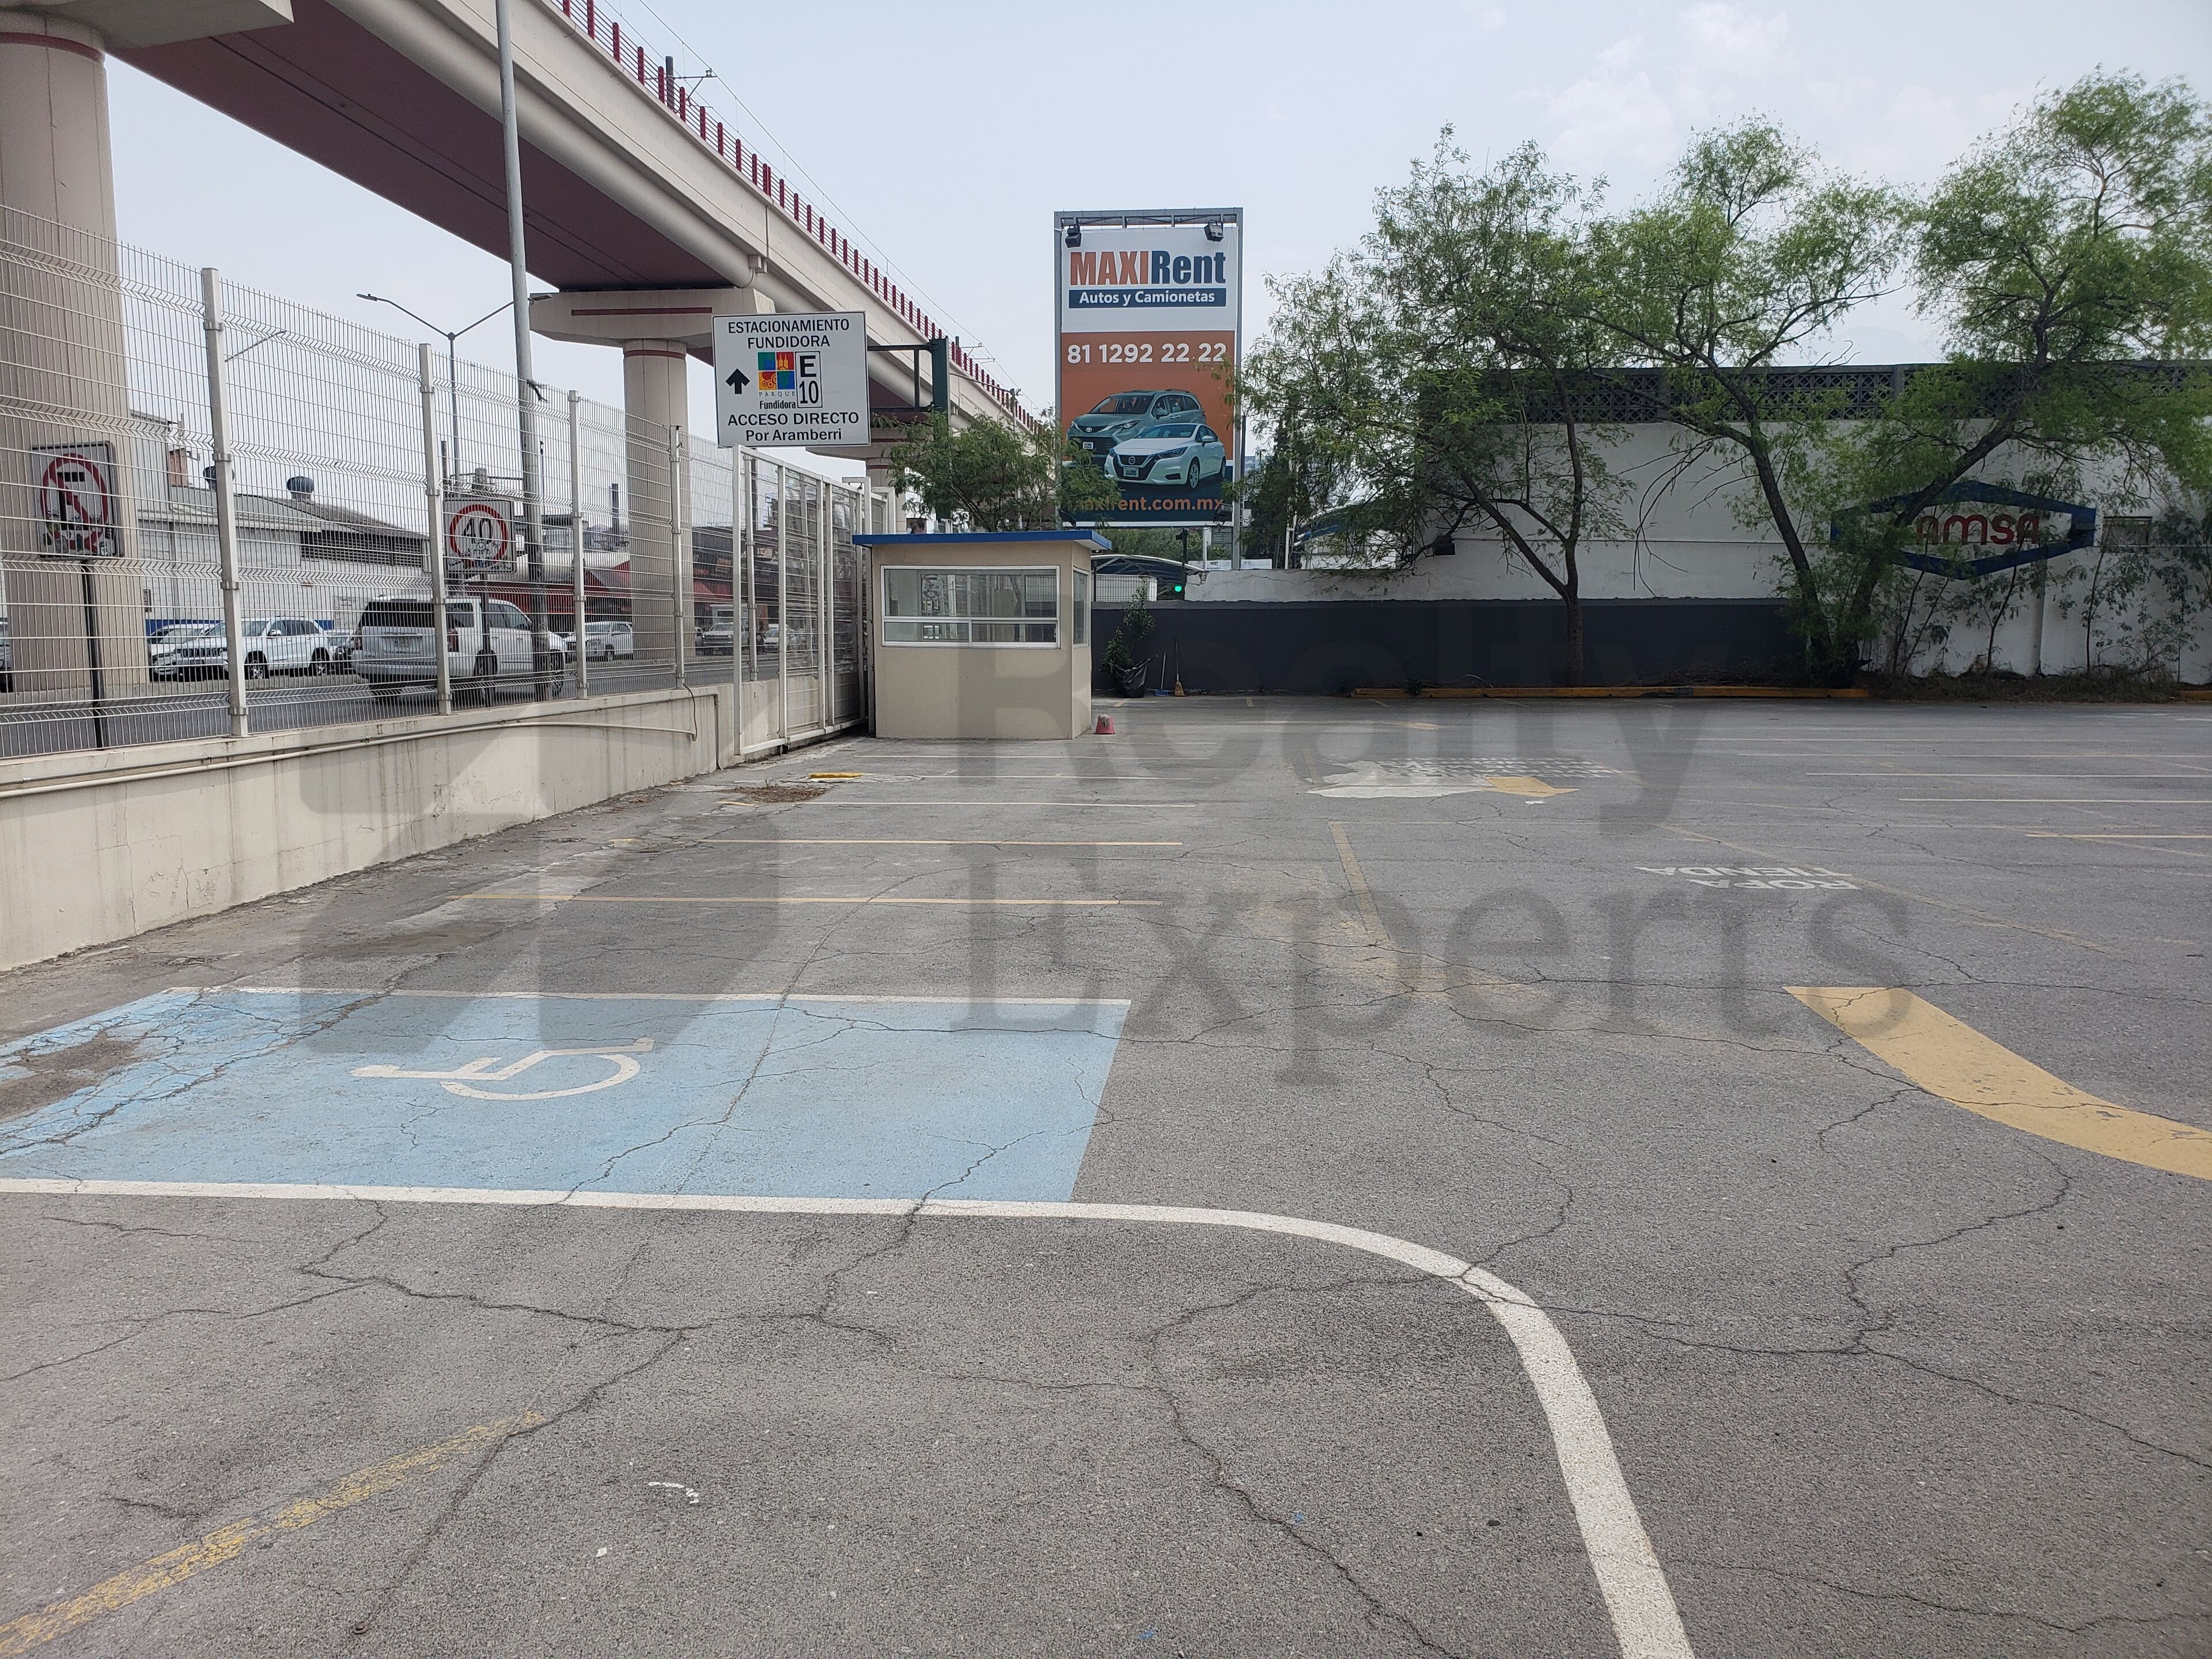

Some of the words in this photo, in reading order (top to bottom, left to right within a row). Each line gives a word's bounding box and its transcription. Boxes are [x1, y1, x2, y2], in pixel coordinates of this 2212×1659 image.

[1069, 250, 1226, 286] MAXIRent
[1079, 291, 1119, 304] Autos
[1123, 294, 1131, 306] y
[1134, 290, 1215, 303] Camionetas
[728, 319, 850, 334] ESTACIONAMIENTO
[747, 335, 831, 349] FUNDIDORA
[1067, 344, 1090, 363] 81
[1099, 343, 1153, 363] 1292
[800, 355, 817, 378] E
[798, 380, 819, 404] 10
[759, 400, 797, 410] Fundidora
[728, 413, 789, 426] ACCESO
[793, 412, 859, 425] DIRECTO
[745, 430, 769, 442] Por
[772, 428, 842, 441] Aramberri
[461, 517, 494, 544] 40
[1634, 866, 1853, 877] TIENDA
[1686, 879, 1862, 891] ROPA
